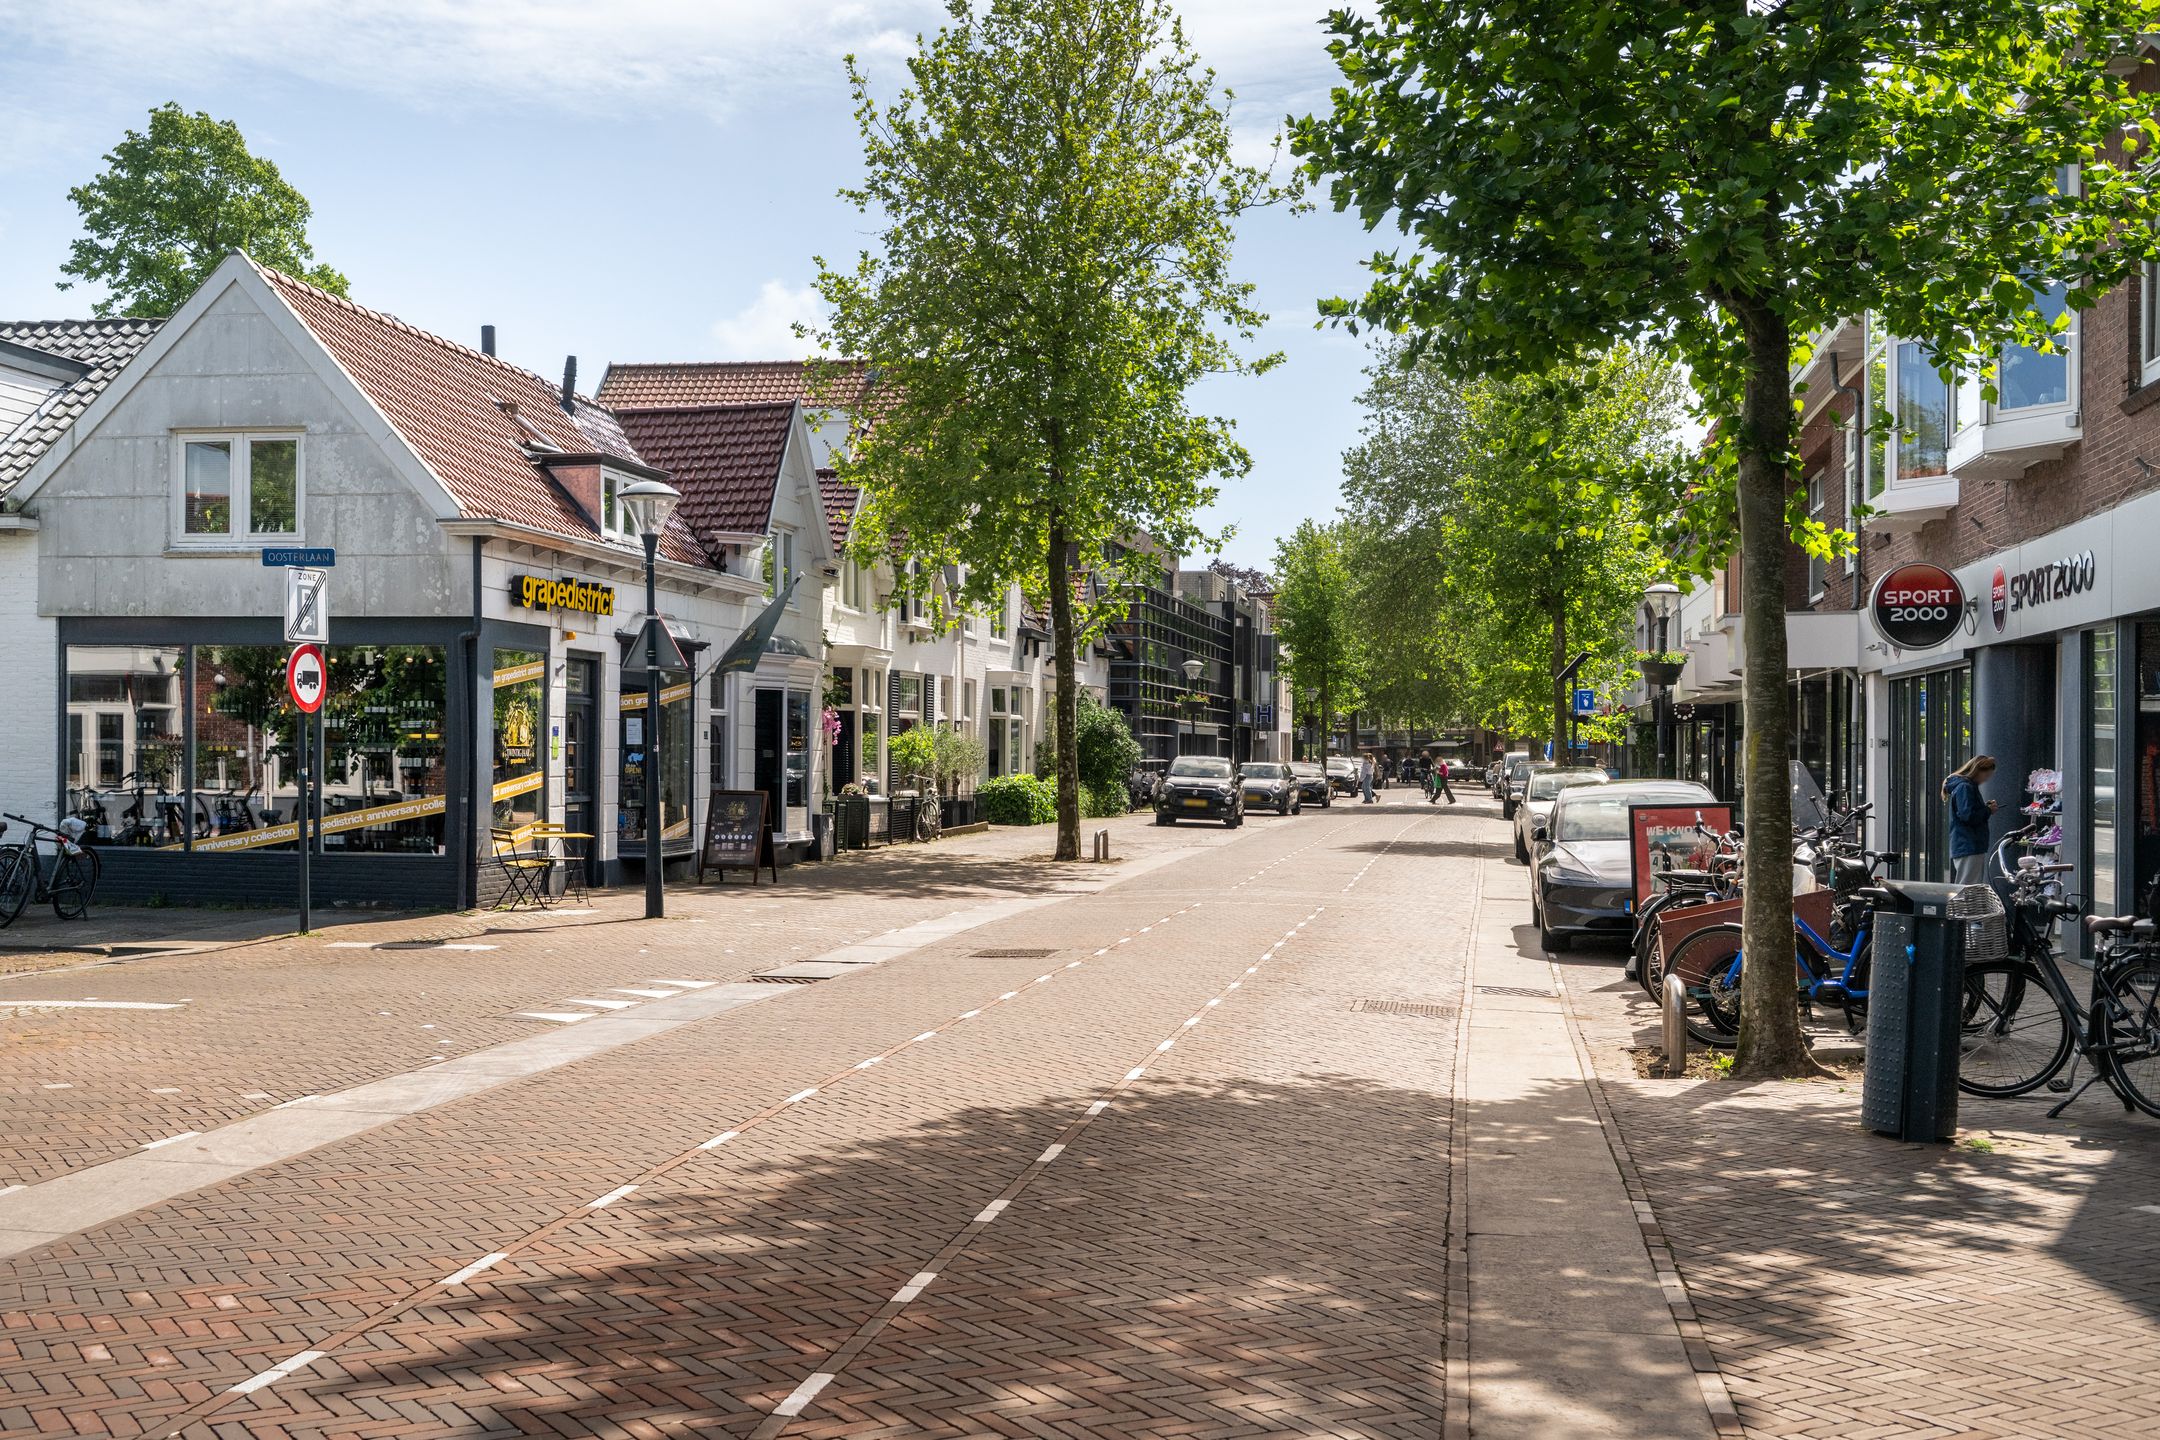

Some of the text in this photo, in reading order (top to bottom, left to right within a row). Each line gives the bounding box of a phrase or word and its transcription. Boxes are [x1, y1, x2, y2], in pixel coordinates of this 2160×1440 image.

[267, 552, 330, 562] OOSTERLAAN
[298, 572, 317, 582] ZONE
[522, 575, 616, 616] grapedistrict
[1884, 589, 1954, 605] SPORT
[1992, 584, 2005, 599] SPORT
[1993, 599, 2004, 612] 2000
[1890, 606, 1948, 622] 2000
[366, 804, 421, 821] anniversary
[1646, 825, 1664, 836] WE
[196, 827, 296, 851] anniversary collection
[1652, 856, 1659, 868] 4
